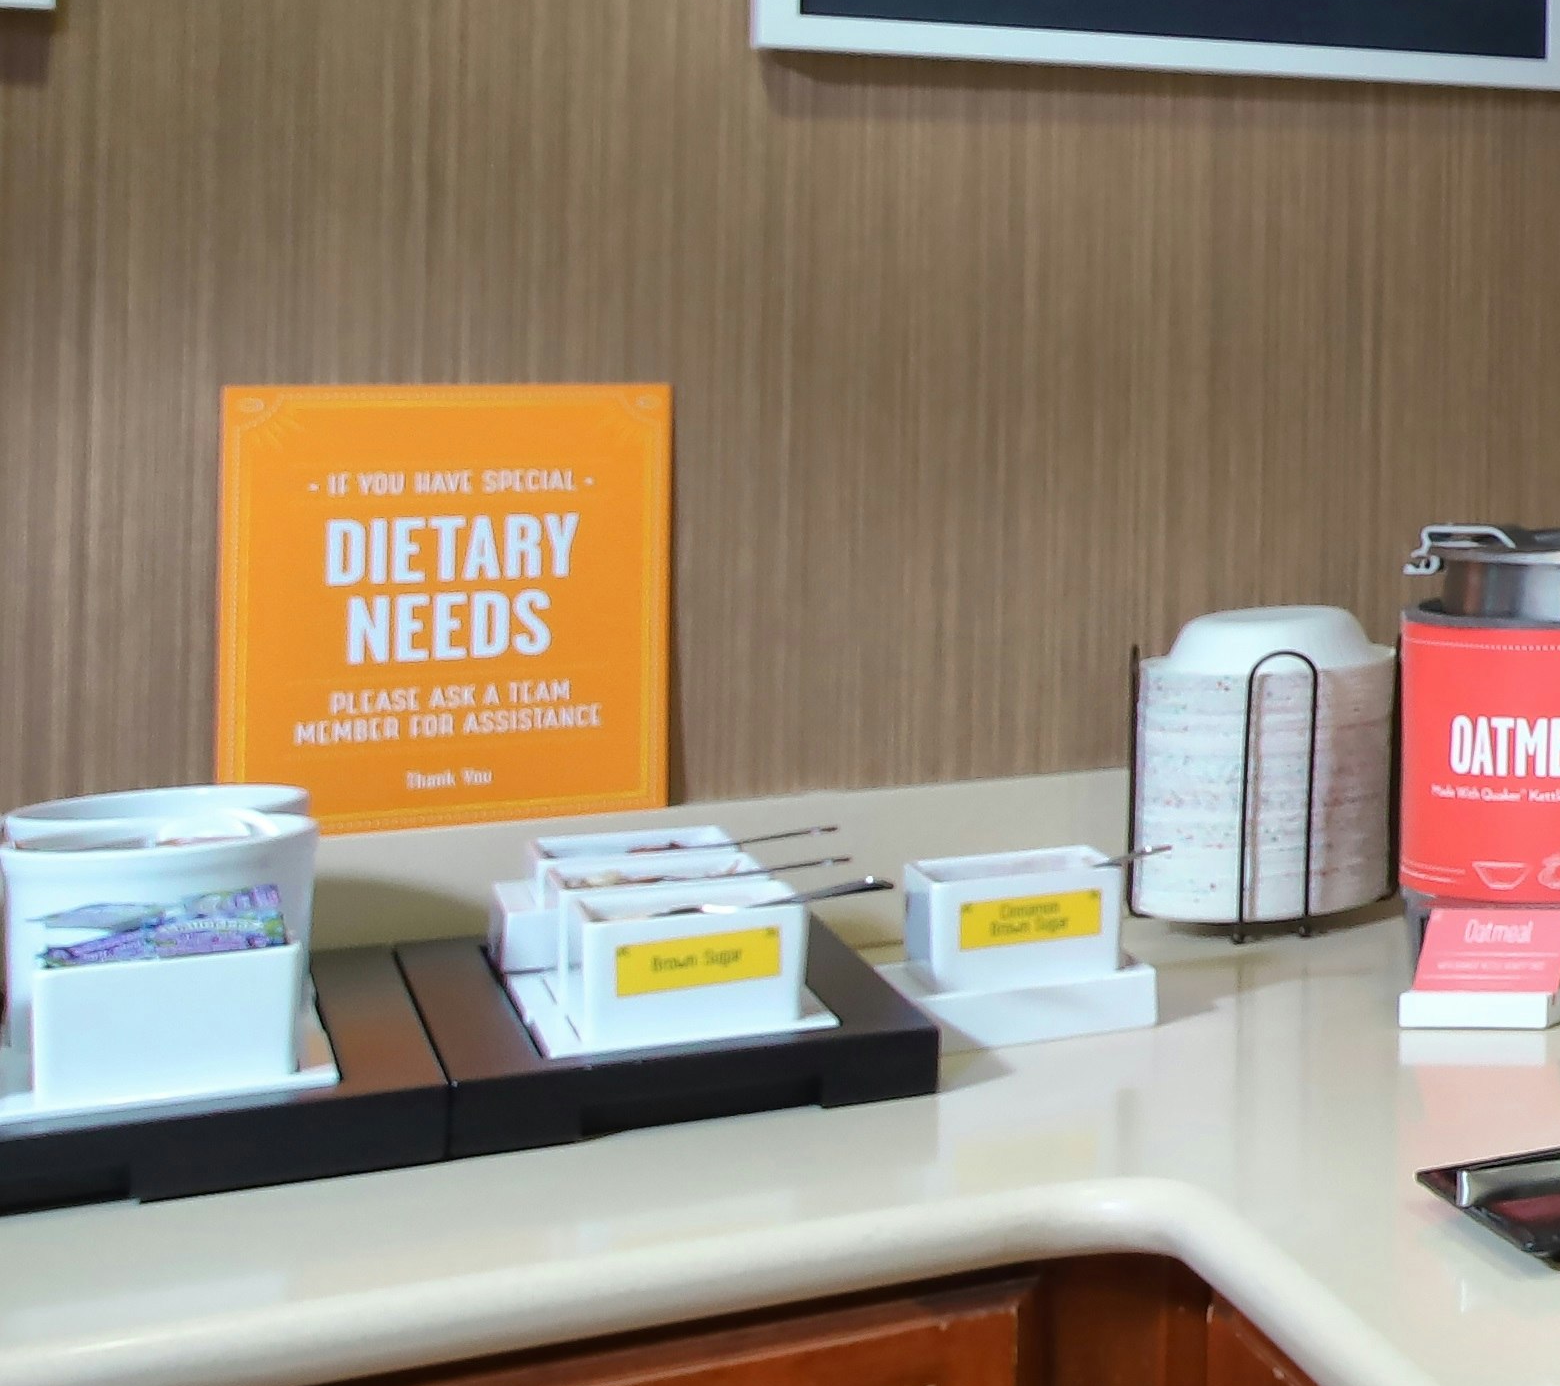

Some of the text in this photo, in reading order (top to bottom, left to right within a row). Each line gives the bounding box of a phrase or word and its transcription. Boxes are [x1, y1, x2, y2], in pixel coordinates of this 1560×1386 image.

[326, 468, 577, 495] IF YOU HAVE SPECIAL
[324, 512, 580, 586] DIETARY
[346, 588, 553, 665] NEEDS
[330, 678, 570, 715] PLEASE ASK A TEAM
[294, 703, 602, 745] MEMBER FOR ASSISTANCE
[1464, 919, 1533, 943] Oatmeal
